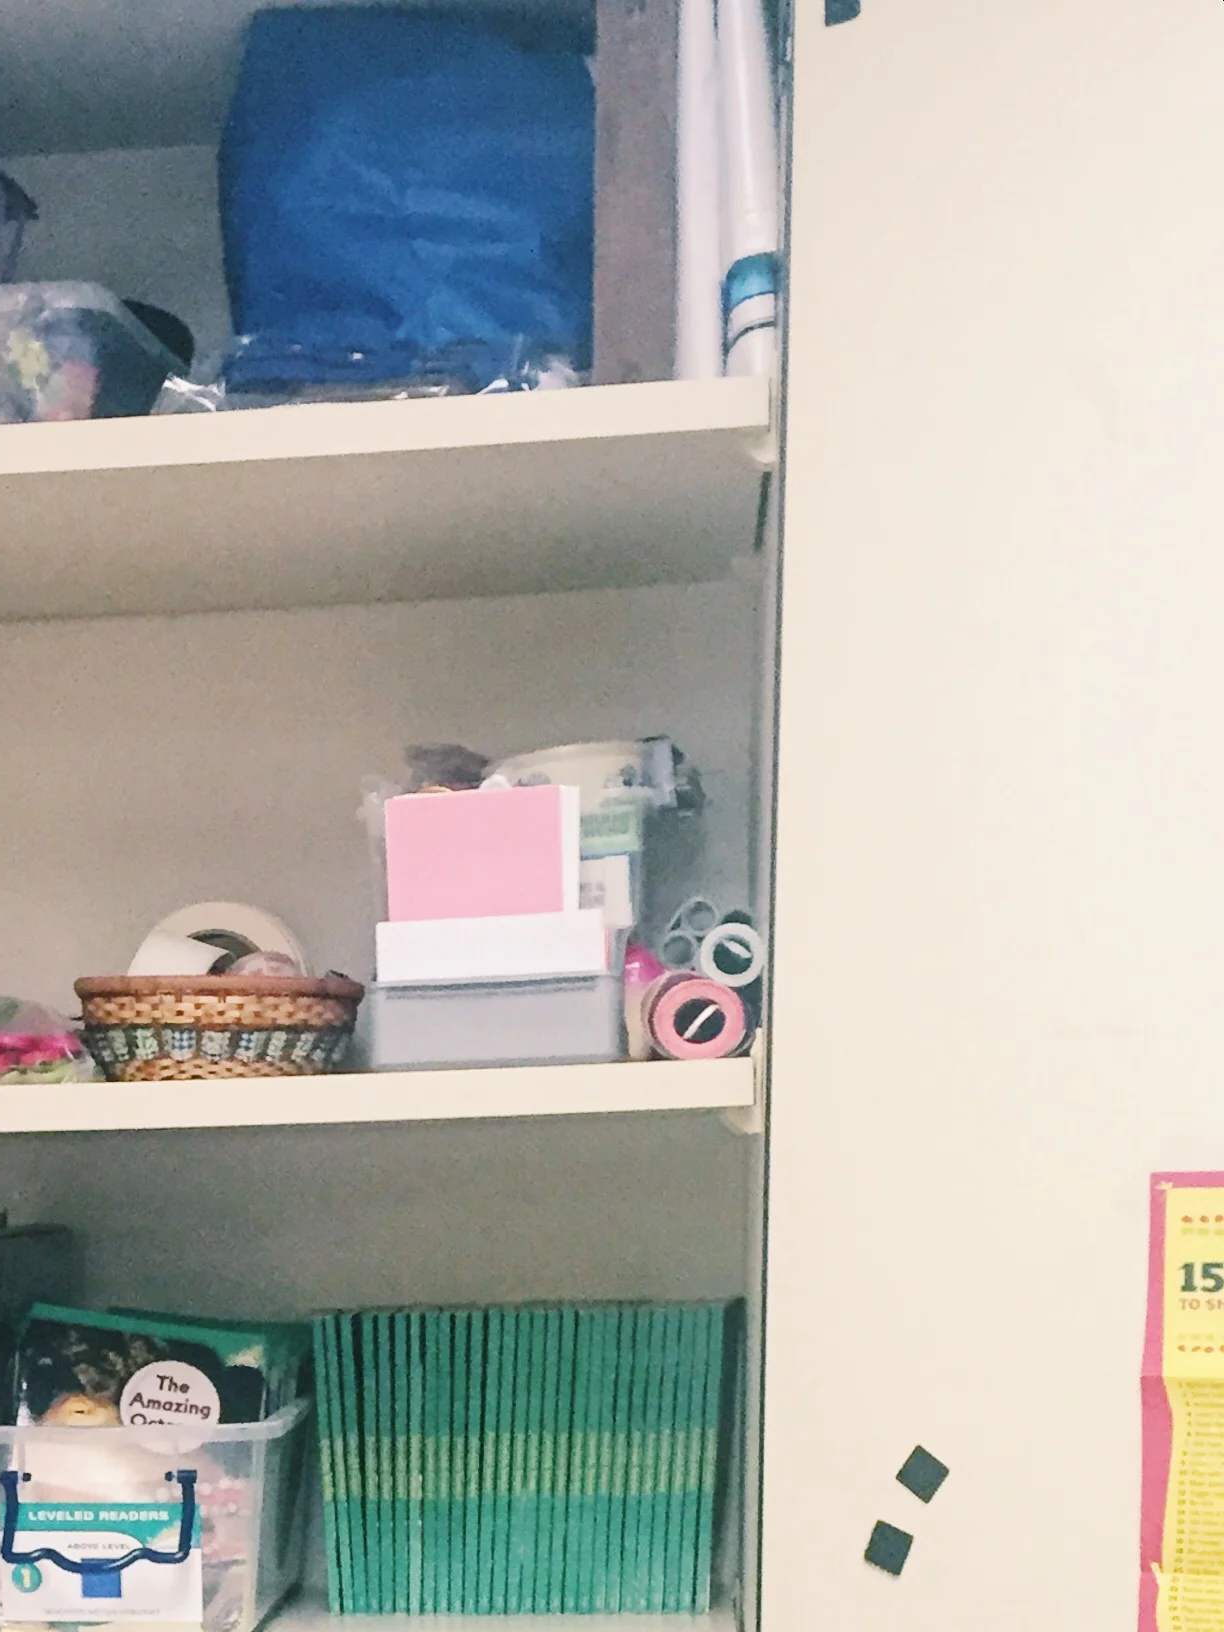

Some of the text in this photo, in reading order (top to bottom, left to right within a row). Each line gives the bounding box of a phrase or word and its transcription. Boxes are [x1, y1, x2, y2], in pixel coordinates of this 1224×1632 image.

[1179, 1298, 1201, 1310] TO
[156, 1374, 190, 1394] The
[129, 1392, 212, 1420] Amazing
[28, 1510, 170, 1522] LEVELED READERS
[20, 1568, 32, 1588] 1
